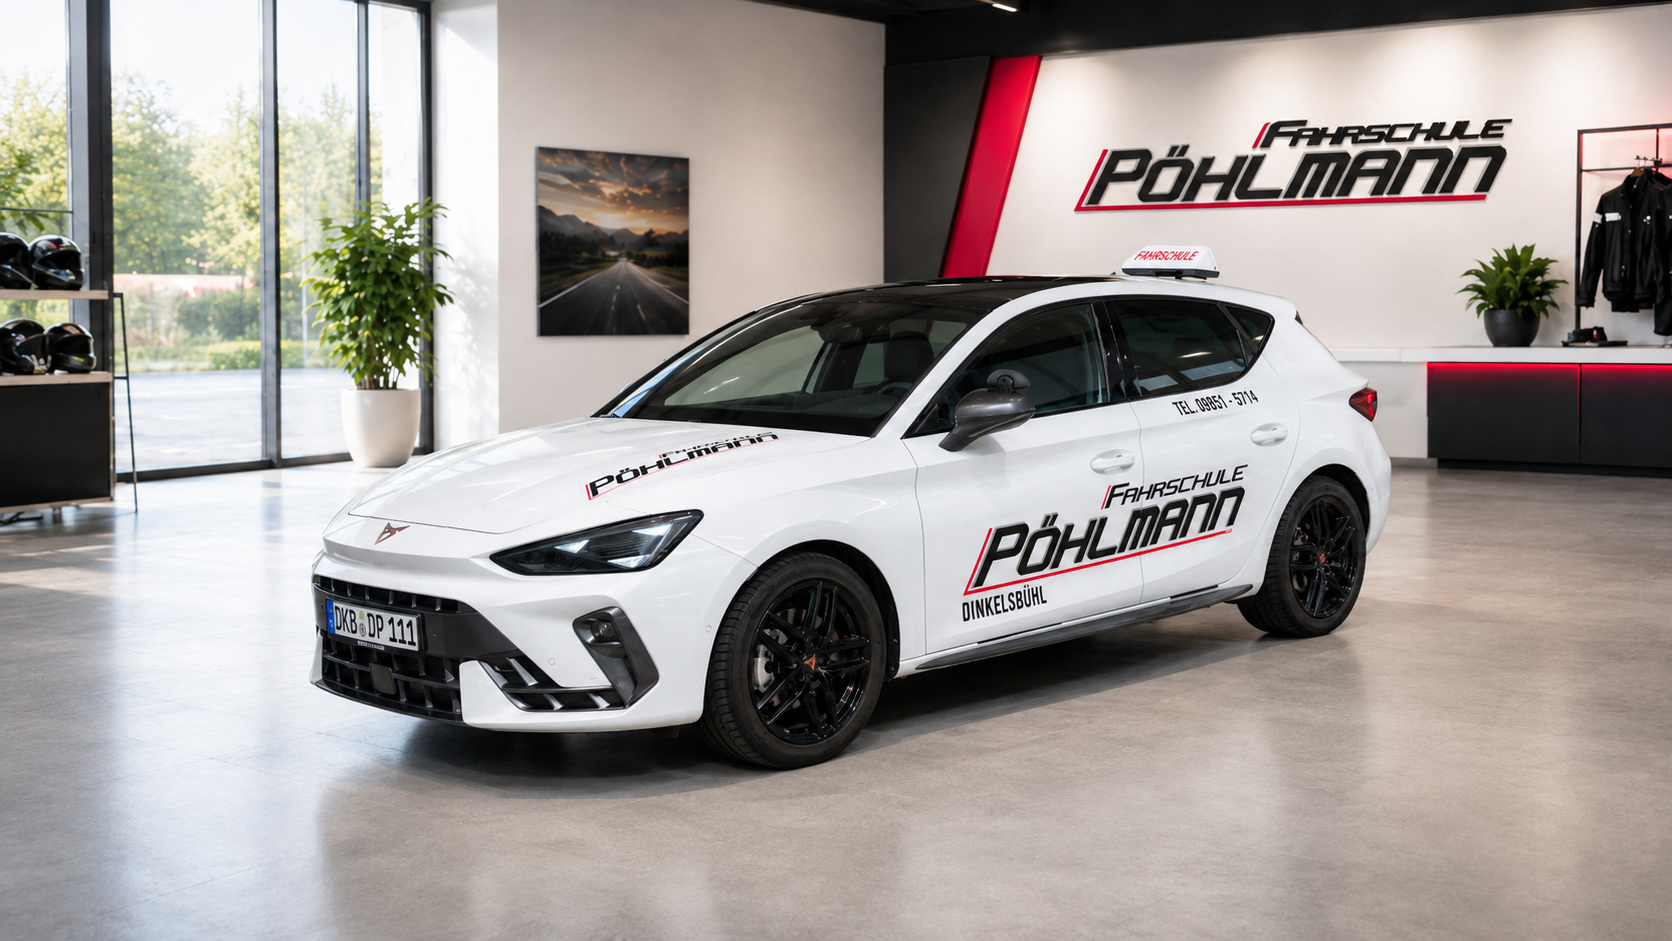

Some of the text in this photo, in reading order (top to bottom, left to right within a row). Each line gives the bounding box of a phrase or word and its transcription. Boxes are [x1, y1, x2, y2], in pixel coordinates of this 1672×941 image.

[1260, 118, 1512, 148] FAHRSCHULE
[1085, 144, 1507, 206] PÖHLMANN
[1134, 250, 1199, 261] FAHRSCHULE
[1172, 401, 1198, 416] TEL.
[1195, 394, 1228, 412] 09851
[1231, 390, 1259, 406] 5714
[1104, 464, 1248, 509] FAHRSCHULE
[970, 485, 1245, 589] PÖHLMANN
[962, 584, 1047, 622] DINKELSBÜHL
[334, 606, 417, 646] DKB DP 111
